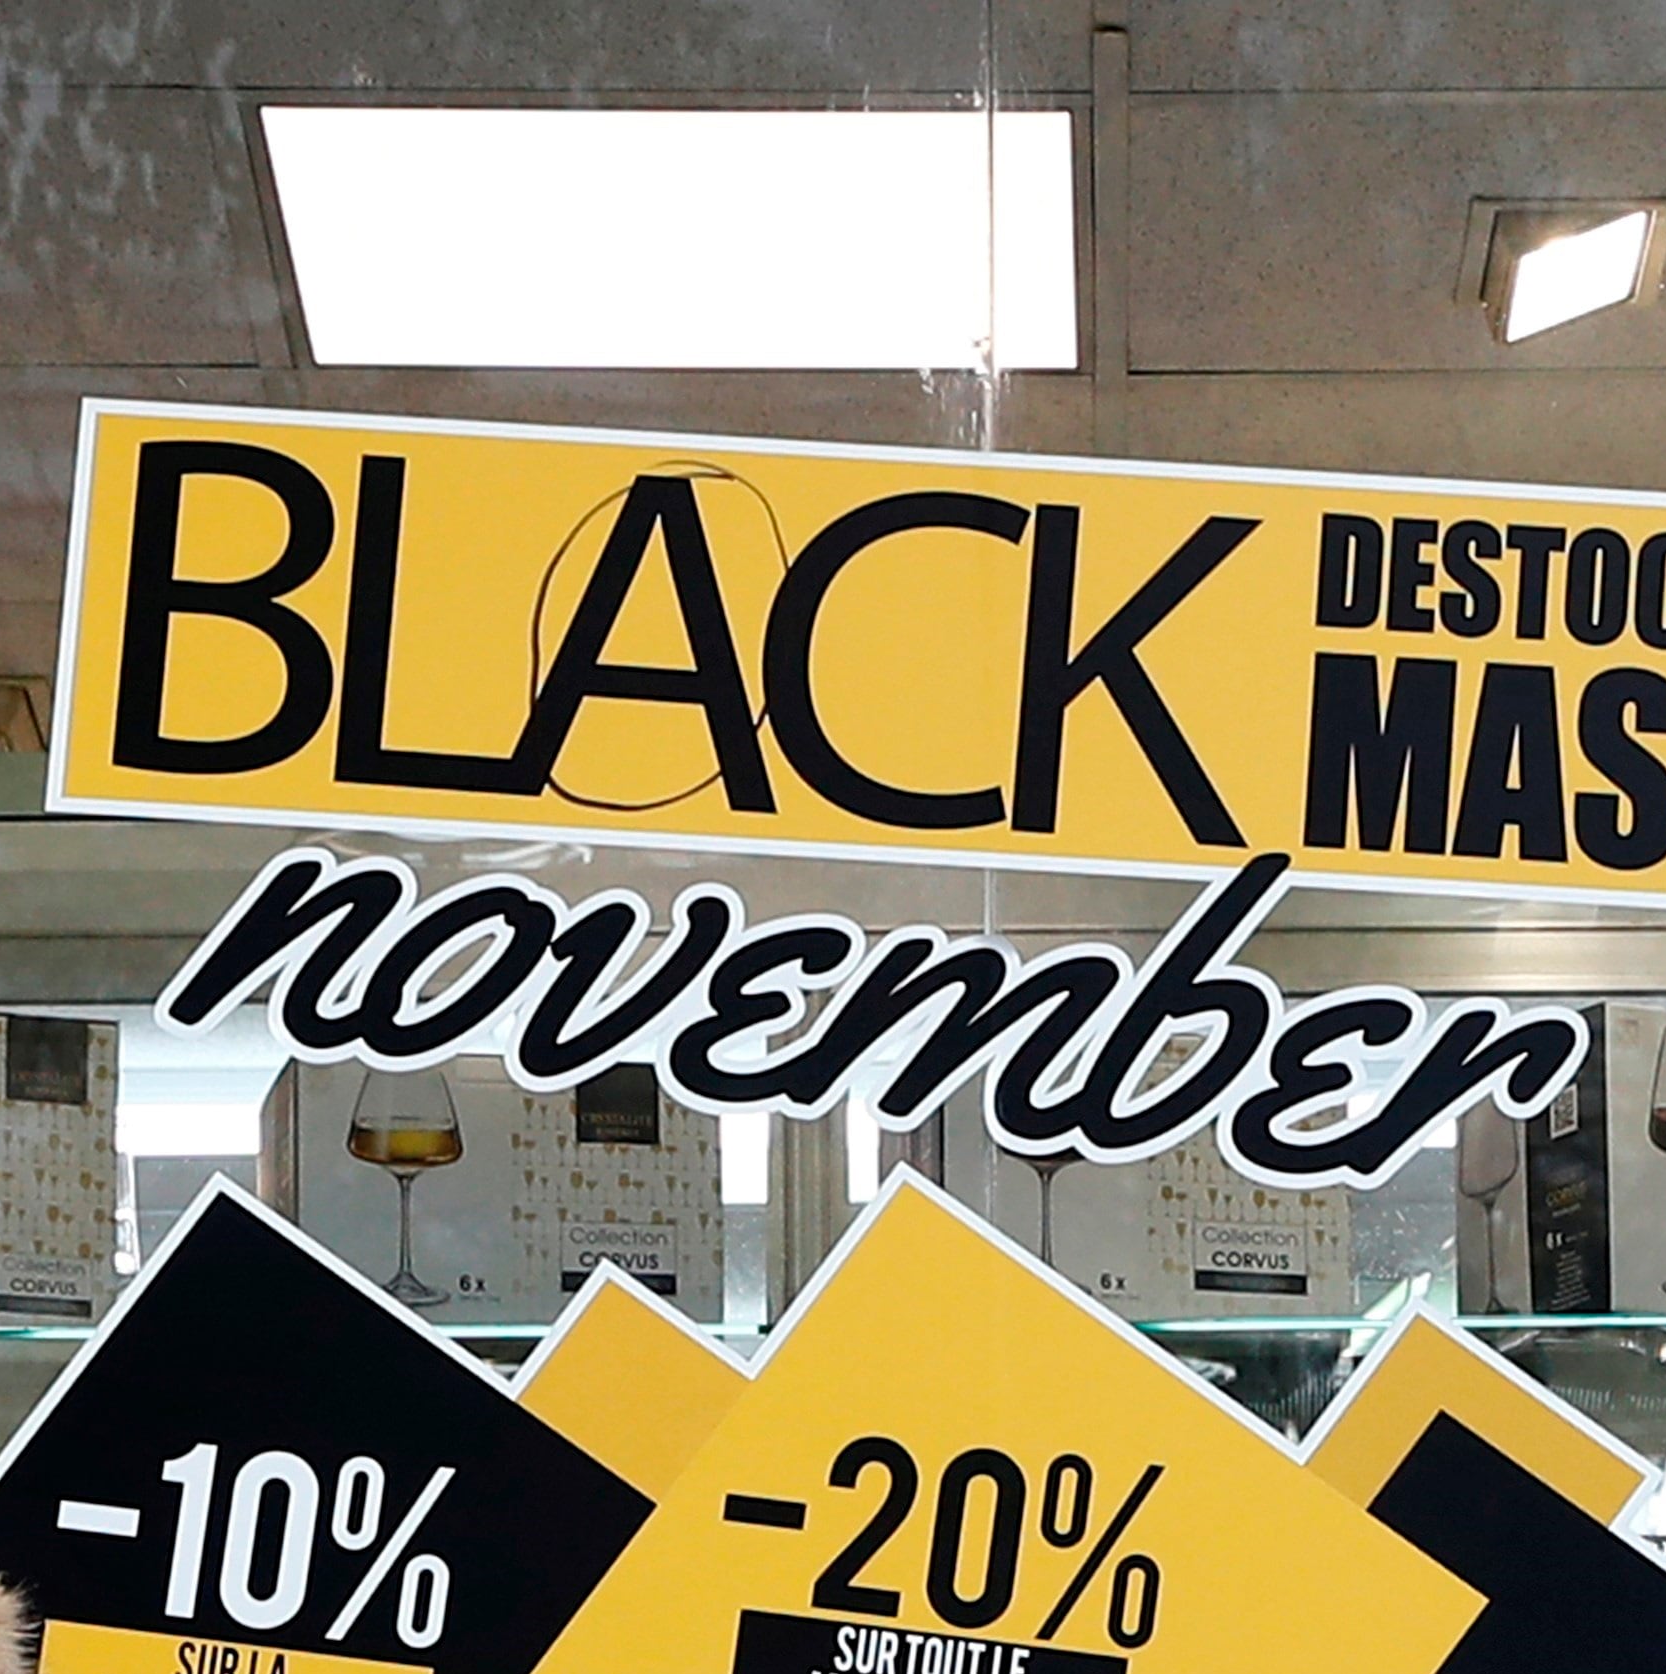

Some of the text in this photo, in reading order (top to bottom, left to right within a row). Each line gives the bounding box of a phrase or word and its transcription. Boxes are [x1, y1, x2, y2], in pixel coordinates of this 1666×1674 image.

[111, 439, 1261, 849] BLACK
[170, 853, 1580, 1174] november
[569, 1227, 668, 1247] Collection
[1202, 1226, 1299, 1247] Collection
[1, 1255, 86, 1276] Collection
[1211, 1251, 1289, 1270] CORVUS
[10, 1278, 77, 1296] CORVUS
[57, 1443, 456, 1648] -10%
[723, 1437, 1165, 1649] -20%
